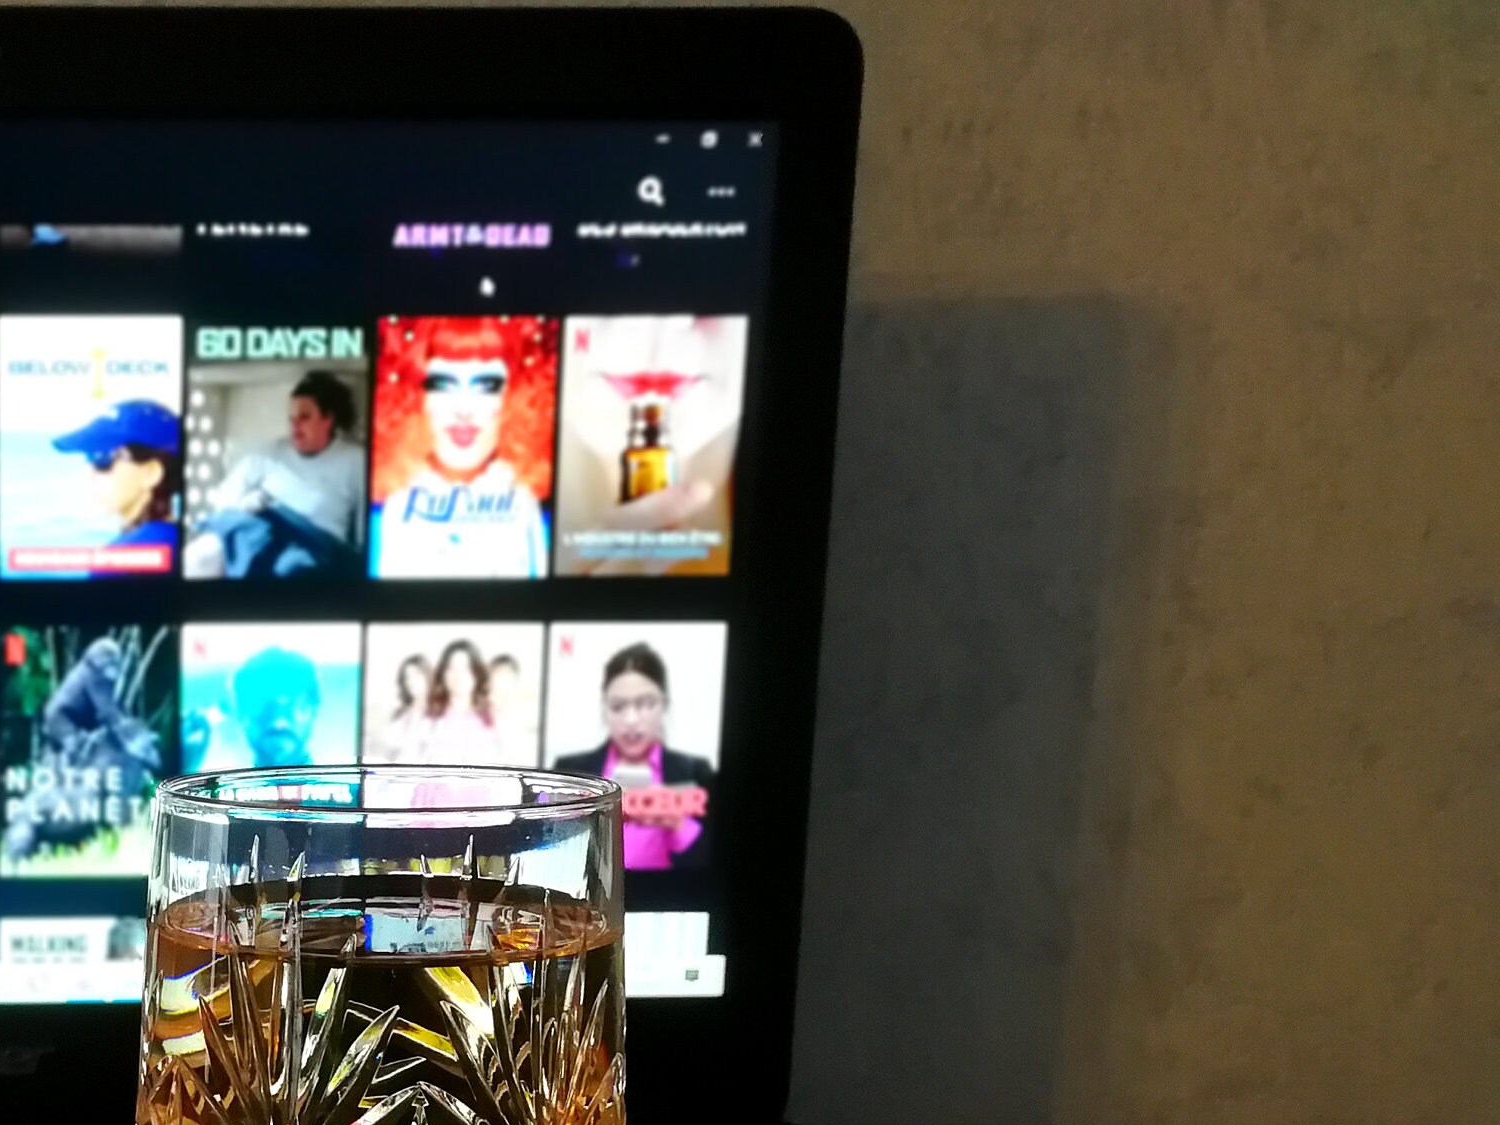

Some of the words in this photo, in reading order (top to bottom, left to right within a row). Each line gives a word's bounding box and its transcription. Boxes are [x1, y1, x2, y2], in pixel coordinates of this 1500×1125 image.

[196, 327, 238, 359] 60
[247, 327, 327, 359] DAYS
[331, 327, 363, 358] IN
[106, 360, 170, 377] DECK
[4, 766, 123, 792] NOTRE
